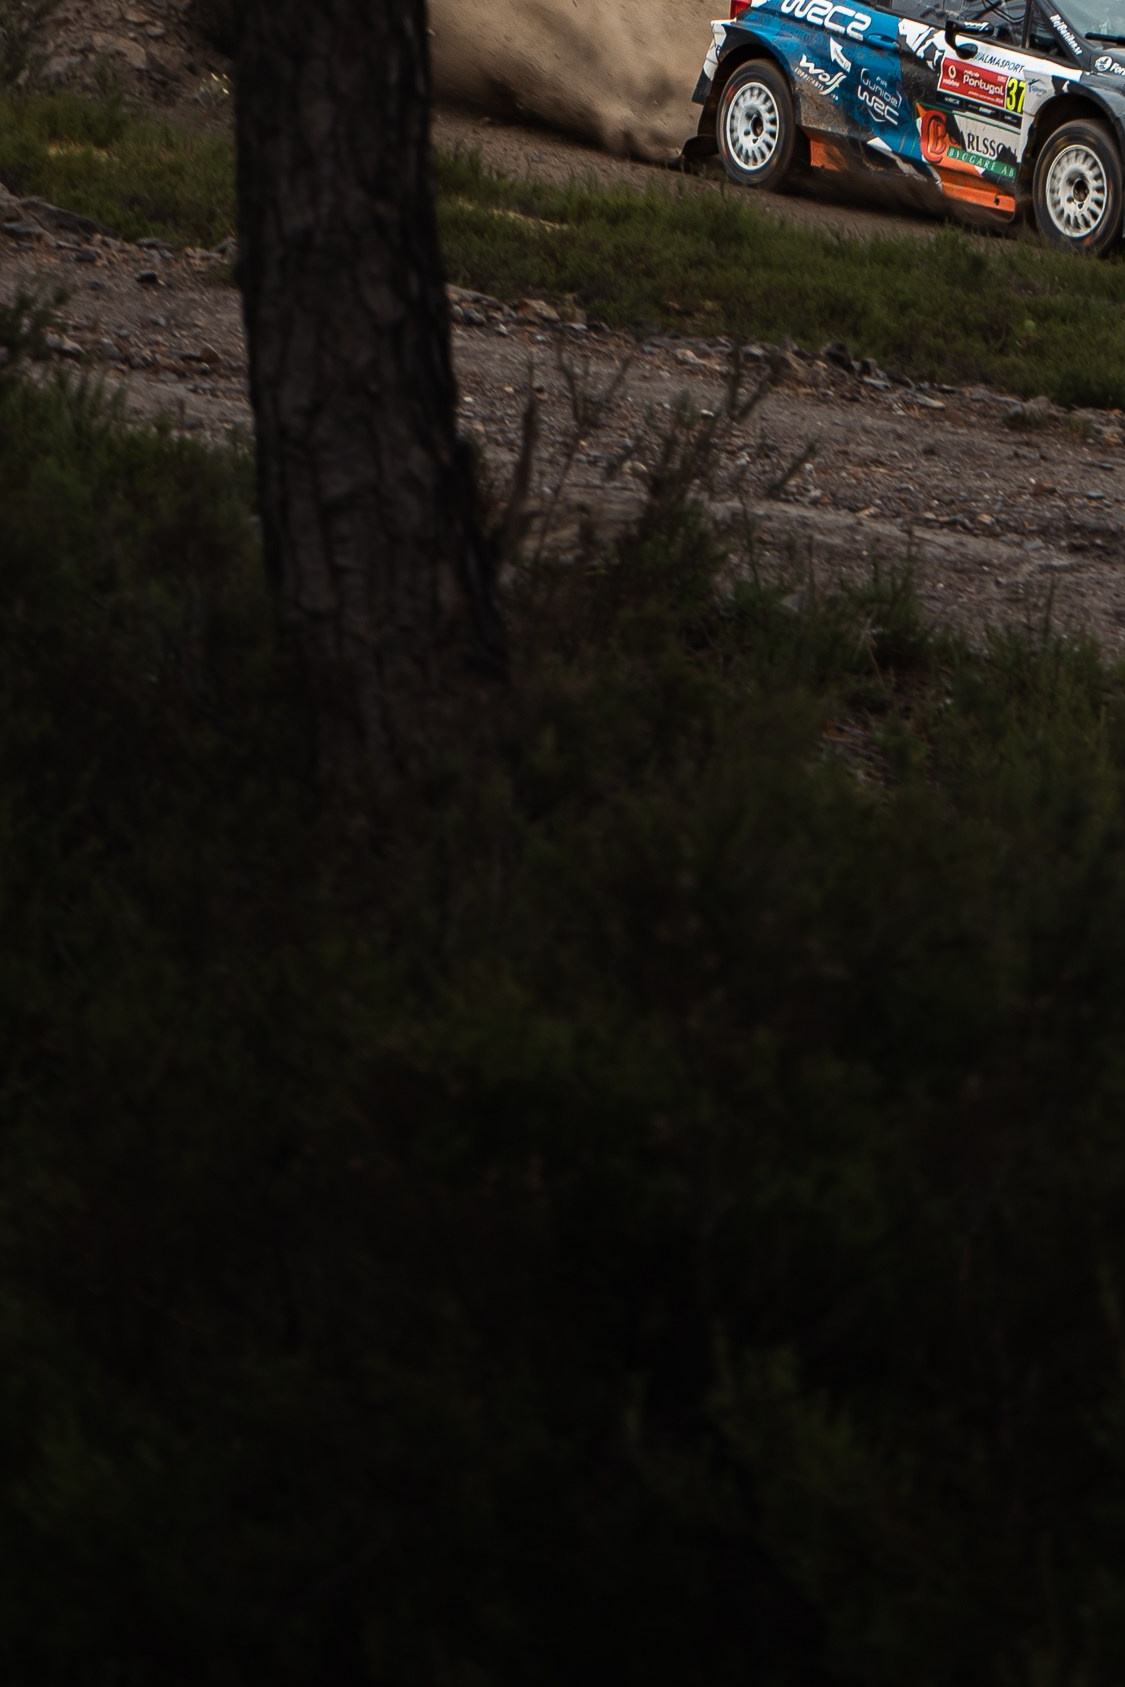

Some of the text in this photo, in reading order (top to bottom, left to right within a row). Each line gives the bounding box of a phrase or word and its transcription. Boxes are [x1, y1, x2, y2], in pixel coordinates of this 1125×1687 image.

[963, 75, 1005, 96] Portugal
[1007, 78, 1027, 113] 37
[858, 85, 899, 125] WRC
[1001, 166, 1015, 177] AB
